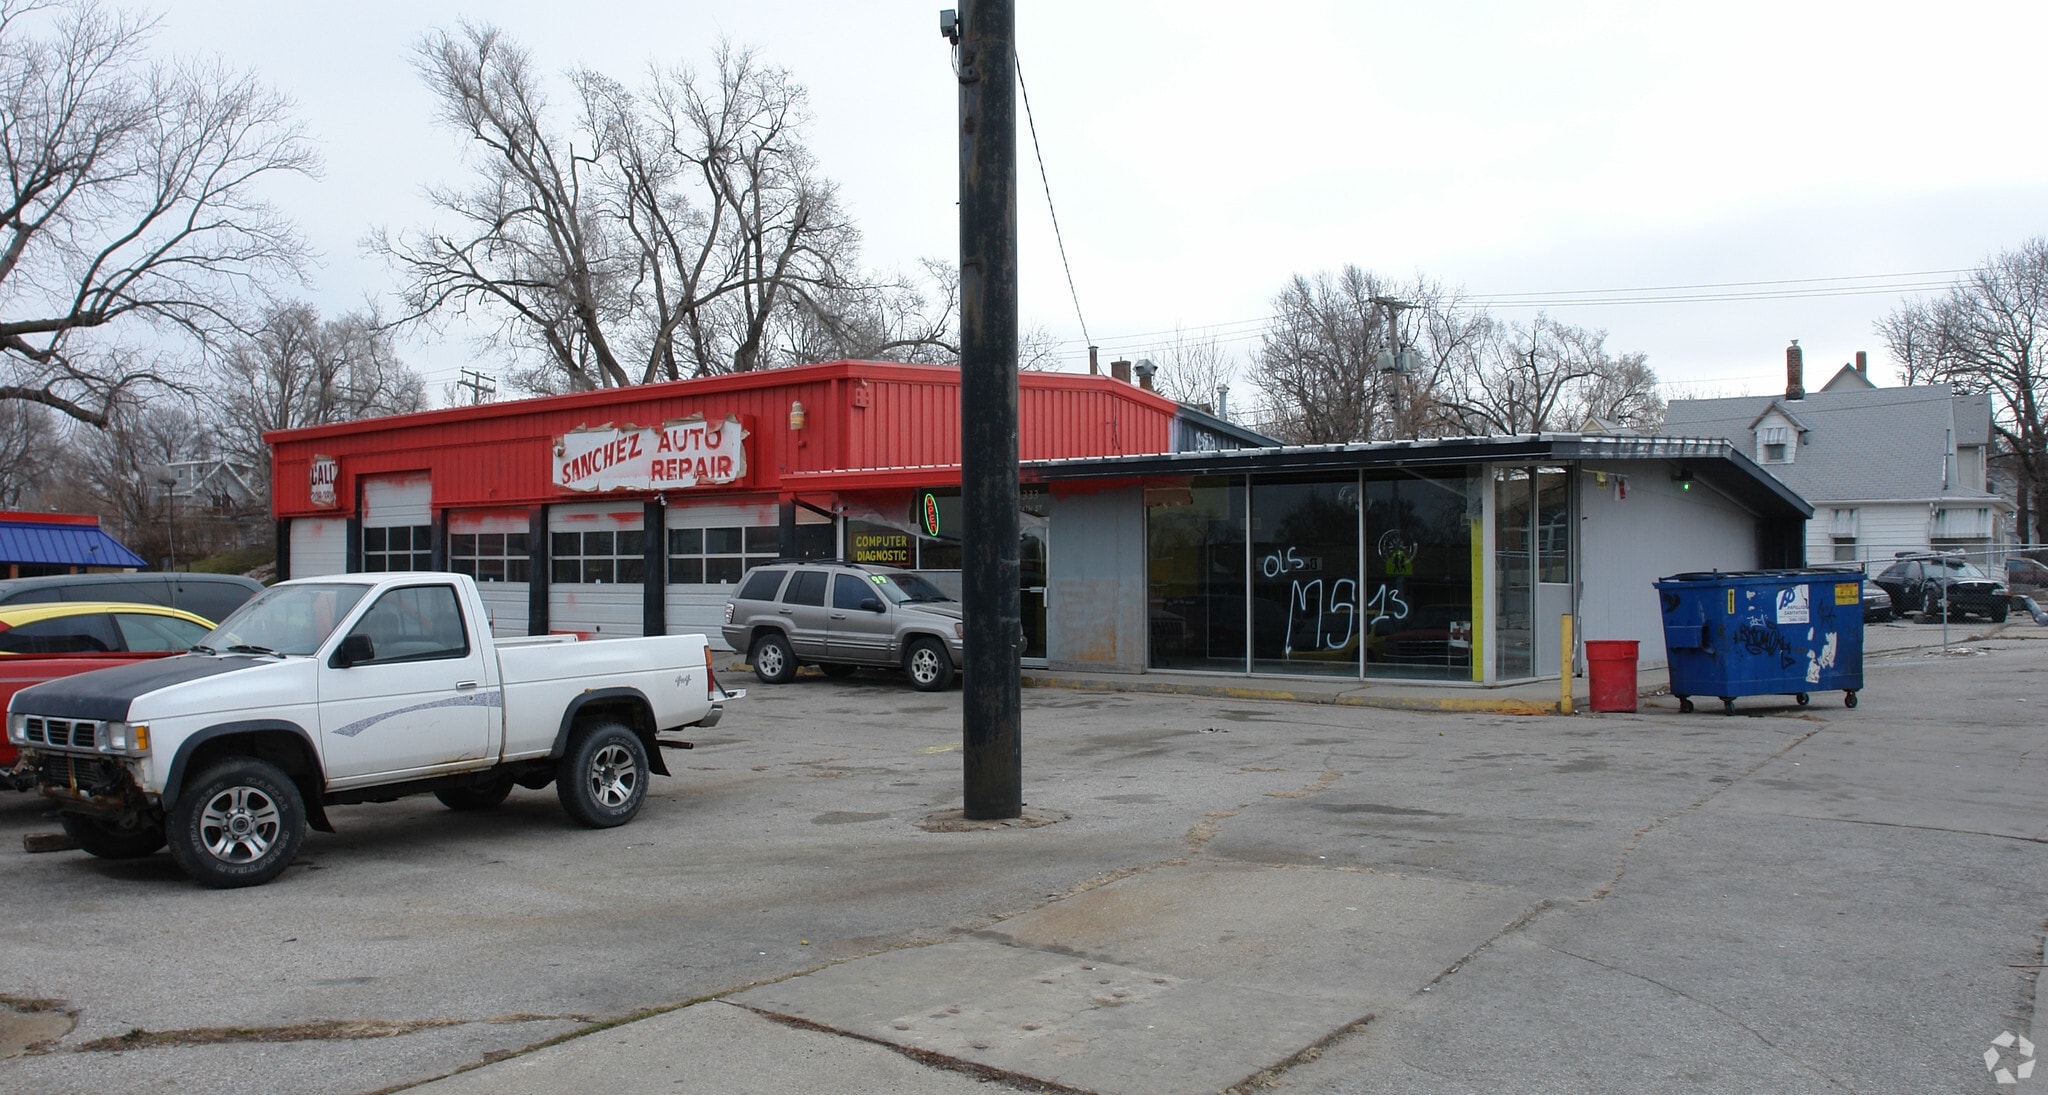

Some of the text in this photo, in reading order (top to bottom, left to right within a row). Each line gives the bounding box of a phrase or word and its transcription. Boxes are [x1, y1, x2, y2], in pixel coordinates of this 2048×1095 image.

[657, 427, 722, 453] AUTO
[562, 432, 643, 485] SANCHEZ
[651, 455, 733, 482] REPAIR
[311, 463, 335, 485] CALL
[926, 496, 937, 533] OPEN
[856, 535, 907, 547] COMPUTER
[857, 550, 907, 562] DIAGNOSTIC
[871, 575, 887, 585] 99
